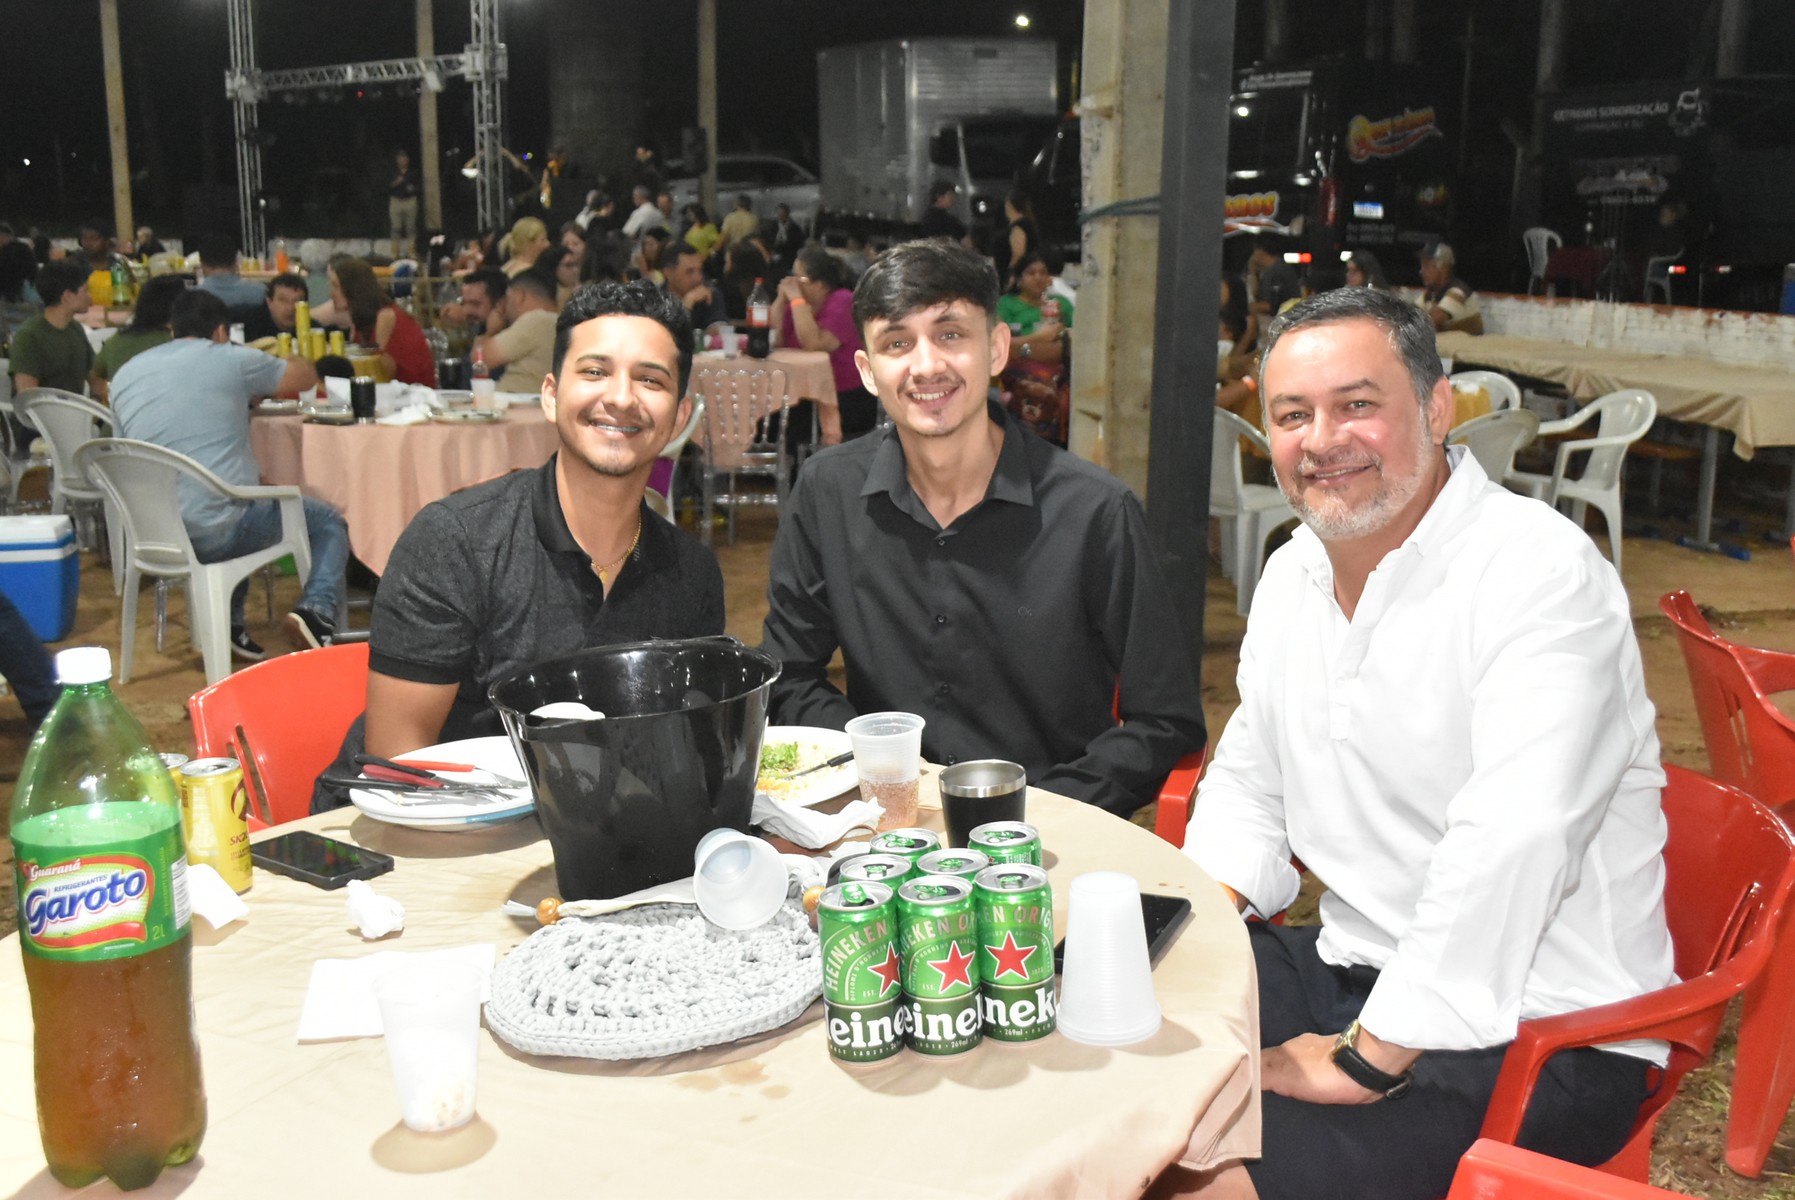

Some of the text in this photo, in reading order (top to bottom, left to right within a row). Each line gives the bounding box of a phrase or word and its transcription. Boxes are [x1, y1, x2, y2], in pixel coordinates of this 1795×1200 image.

[30, 858, 81, 880] Guaraná
[54, 874, 107, 892] REFRIGERANTES
[25, 868, 146, 936] Garoto
[958, 911, 977, 931] OR
[1015, 906, 1053, 929] ORIG
[152, 924, 165, 940] 2L
[826, 919, 888, 992] HEINEKEN
[862, 989, 877, 997] EST.
